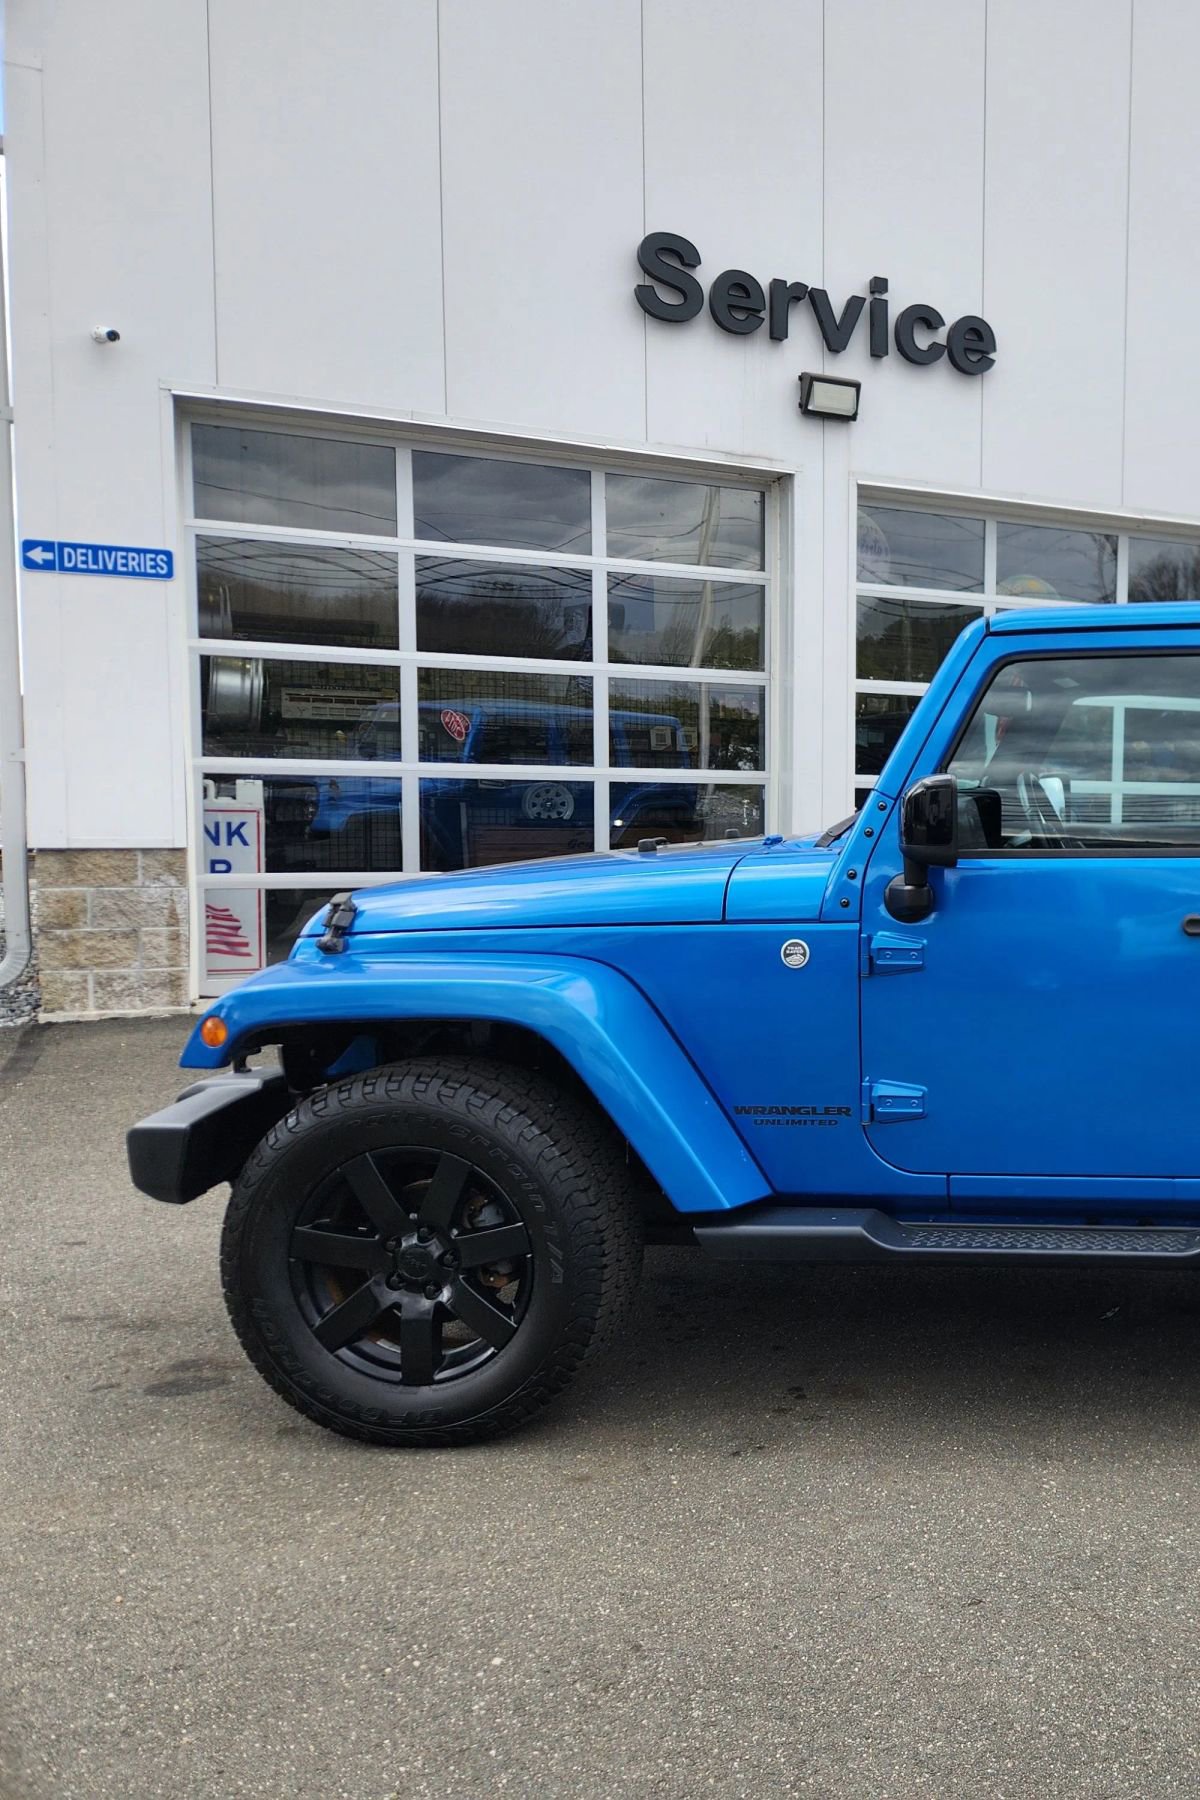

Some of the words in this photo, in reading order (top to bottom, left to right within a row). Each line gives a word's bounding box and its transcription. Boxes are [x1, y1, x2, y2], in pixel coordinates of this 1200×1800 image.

[634, 231, 997, 376] Service
[63, 546, 168, 575] DELIVERIES
[733, 1105, 852, 1117] WRANGLER
[753, 1118, 838, 1127] UNLIMITED
